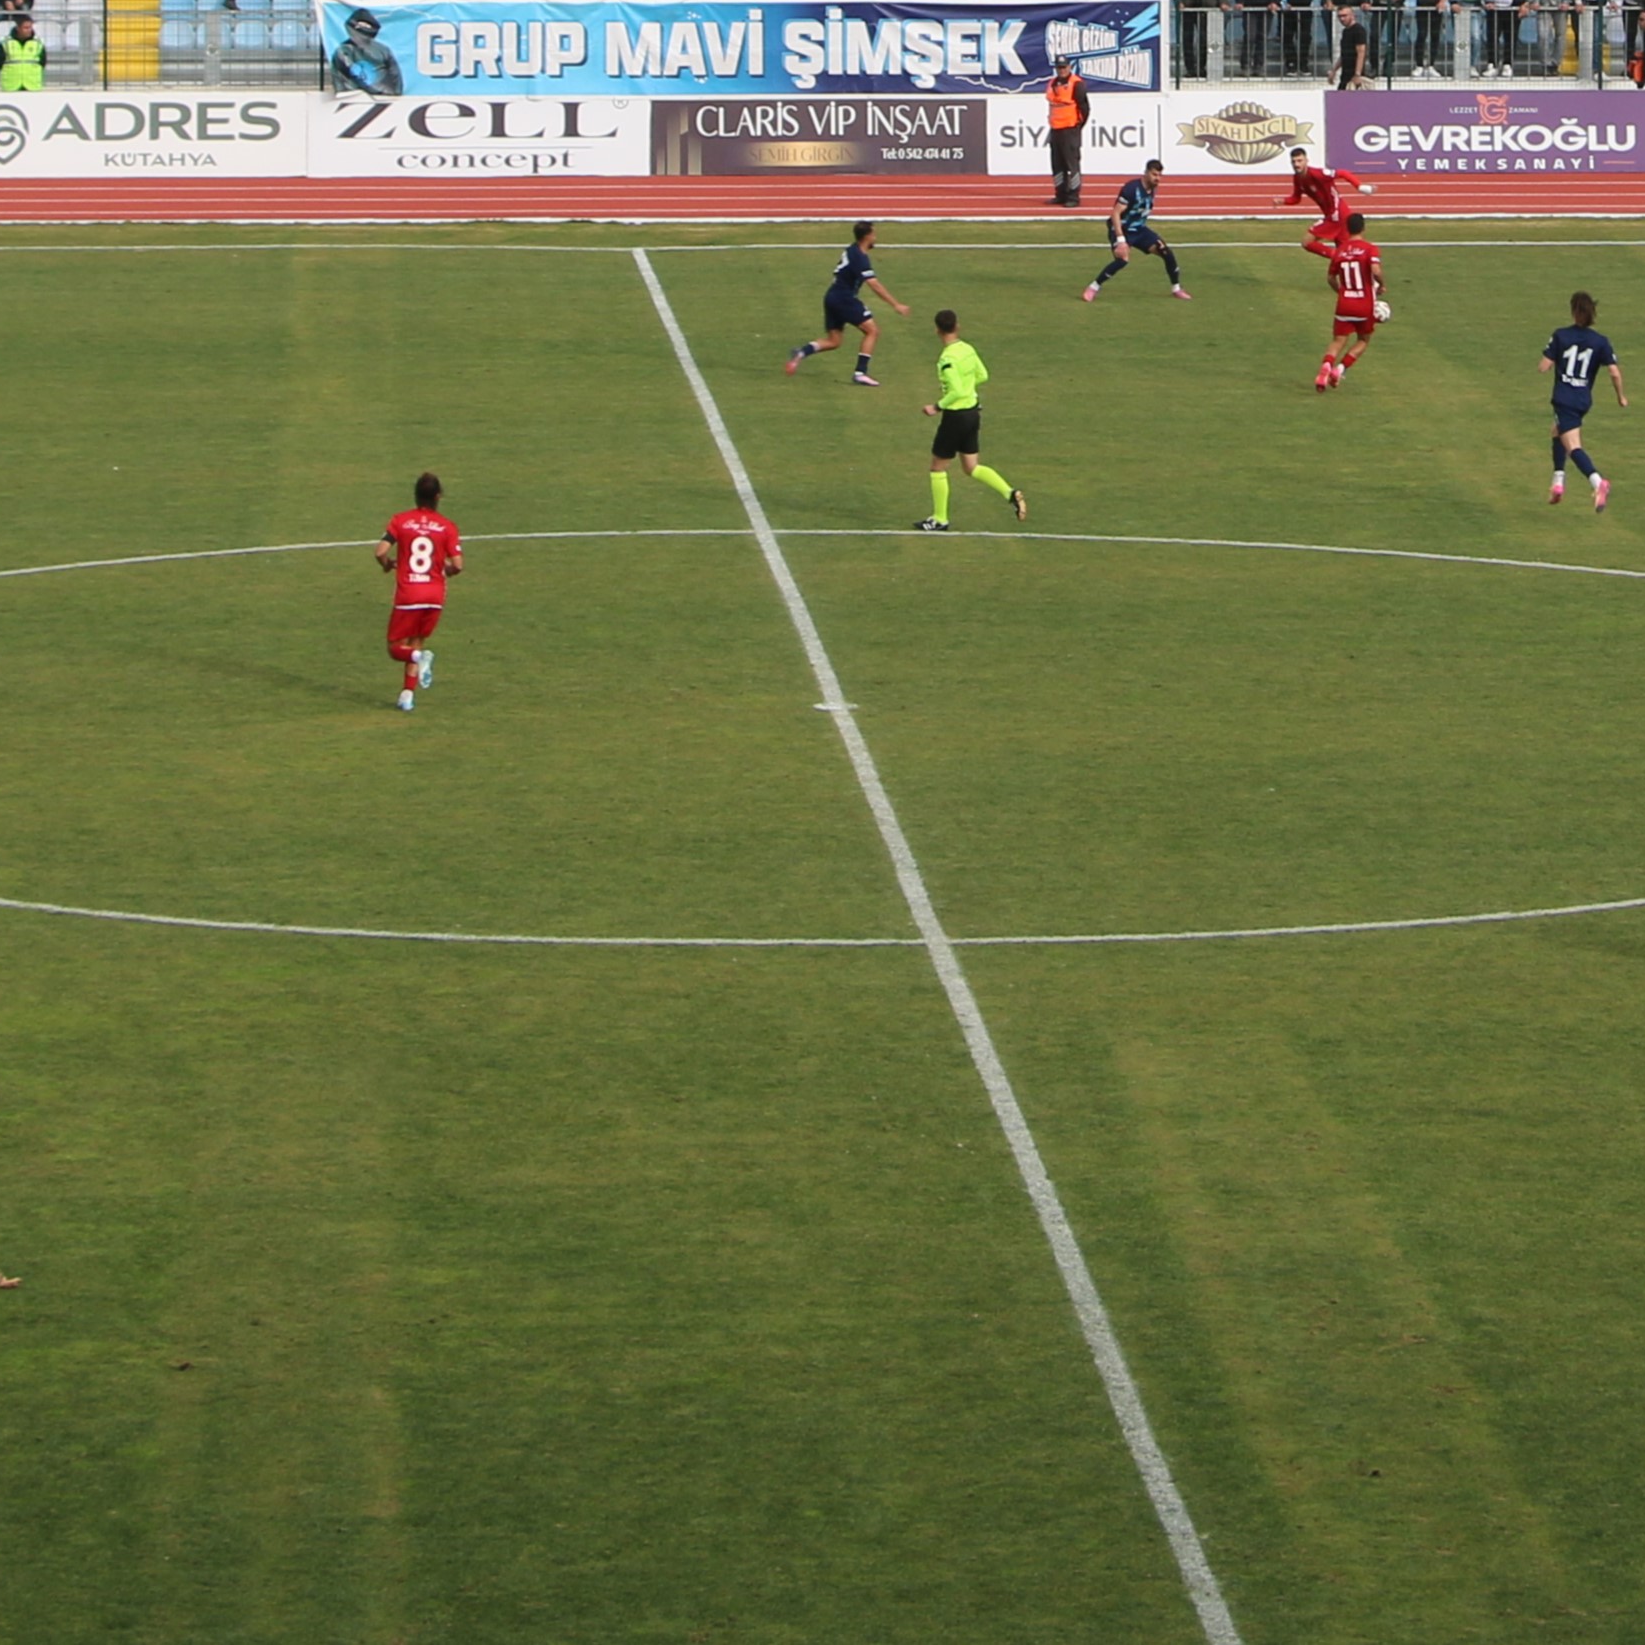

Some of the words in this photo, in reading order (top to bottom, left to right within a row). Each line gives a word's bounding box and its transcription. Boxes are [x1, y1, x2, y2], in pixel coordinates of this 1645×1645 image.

[415, 21, 589, 79] GRUP
[605, 8, 766, 78] MAVİ
[783, 7, 1030, 90] ŞİMŞEK
[42, 101, 281, 141] ADRES
[695, 101, 799, 137] CLARİS
[808, 101, 856, 137] VİP
[866, 101, 968, 144] İNŞAAT
[1449, 106, 1478, 114] LEZZET
[1091, 119, 1146, 148] İNCİ
[1197, 118, 1241, 139] SİYAH
[1245, 116, 1286, 141] İNCİ
[1354, 118, 1636, 152] GEVREKOĞLU
[104, 153, 218, 166] KÜTAHYA
[396, 150, 577, 173] concept
[1397, 158, 1487, 171] YEMEK
[1496, 156, 1595, 171] SANAYİ
[1340, 260, 1364, 290] 11
[1562, 344, 1594, 379] 11
[408, 535, 434, 574] 8
